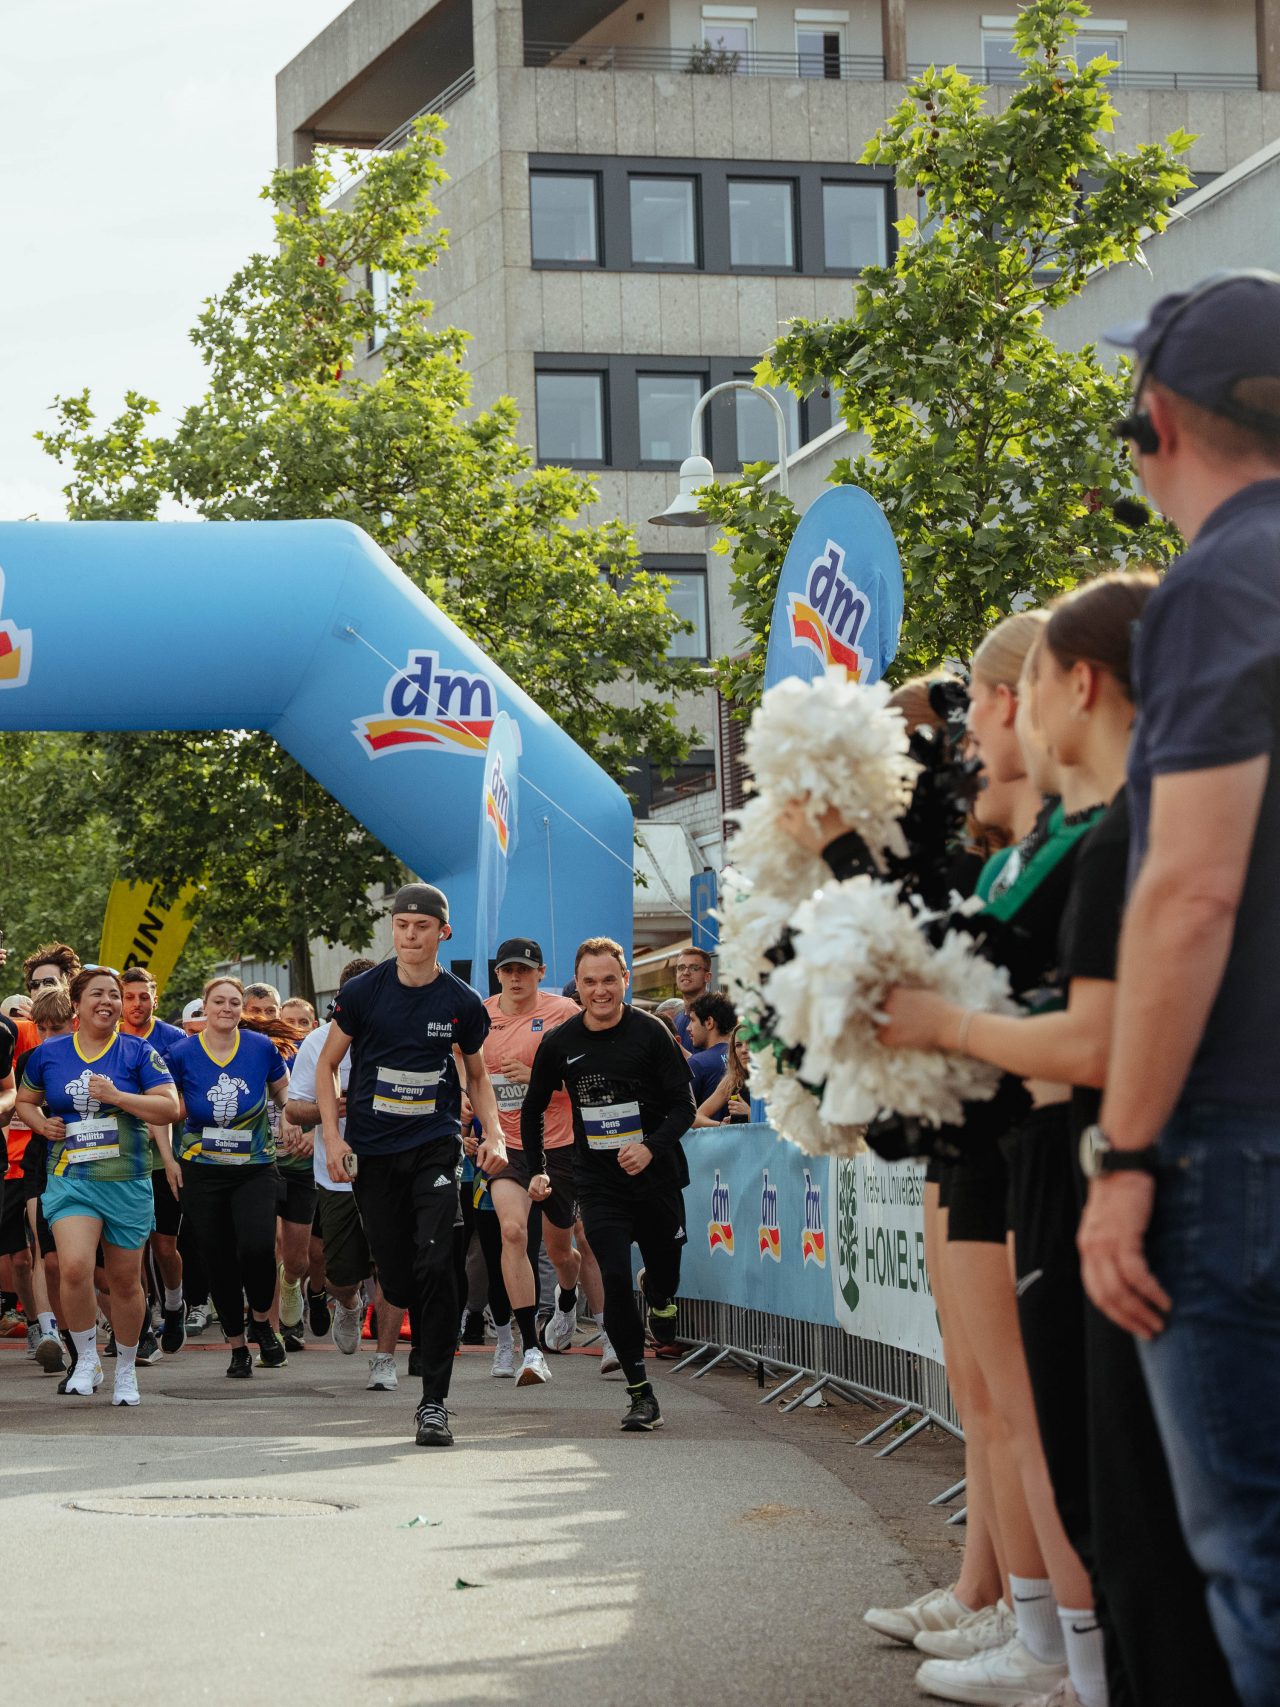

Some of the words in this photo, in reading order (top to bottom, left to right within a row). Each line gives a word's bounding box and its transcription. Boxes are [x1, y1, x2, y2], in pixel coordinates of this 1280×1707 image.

[809, 548, 865, 647] dm
[391, 656, 492, 717] dm
[491, 757, 508, 819] dm
[427, 1022, 452, 1031] #läuft
[391, 1084, 424, 1096] Jeremy
[601, 1120, 621, 1129] Jens
[215, 1139, 239, 1148] Sabine
[712, 1174, 729, 1222] dm
